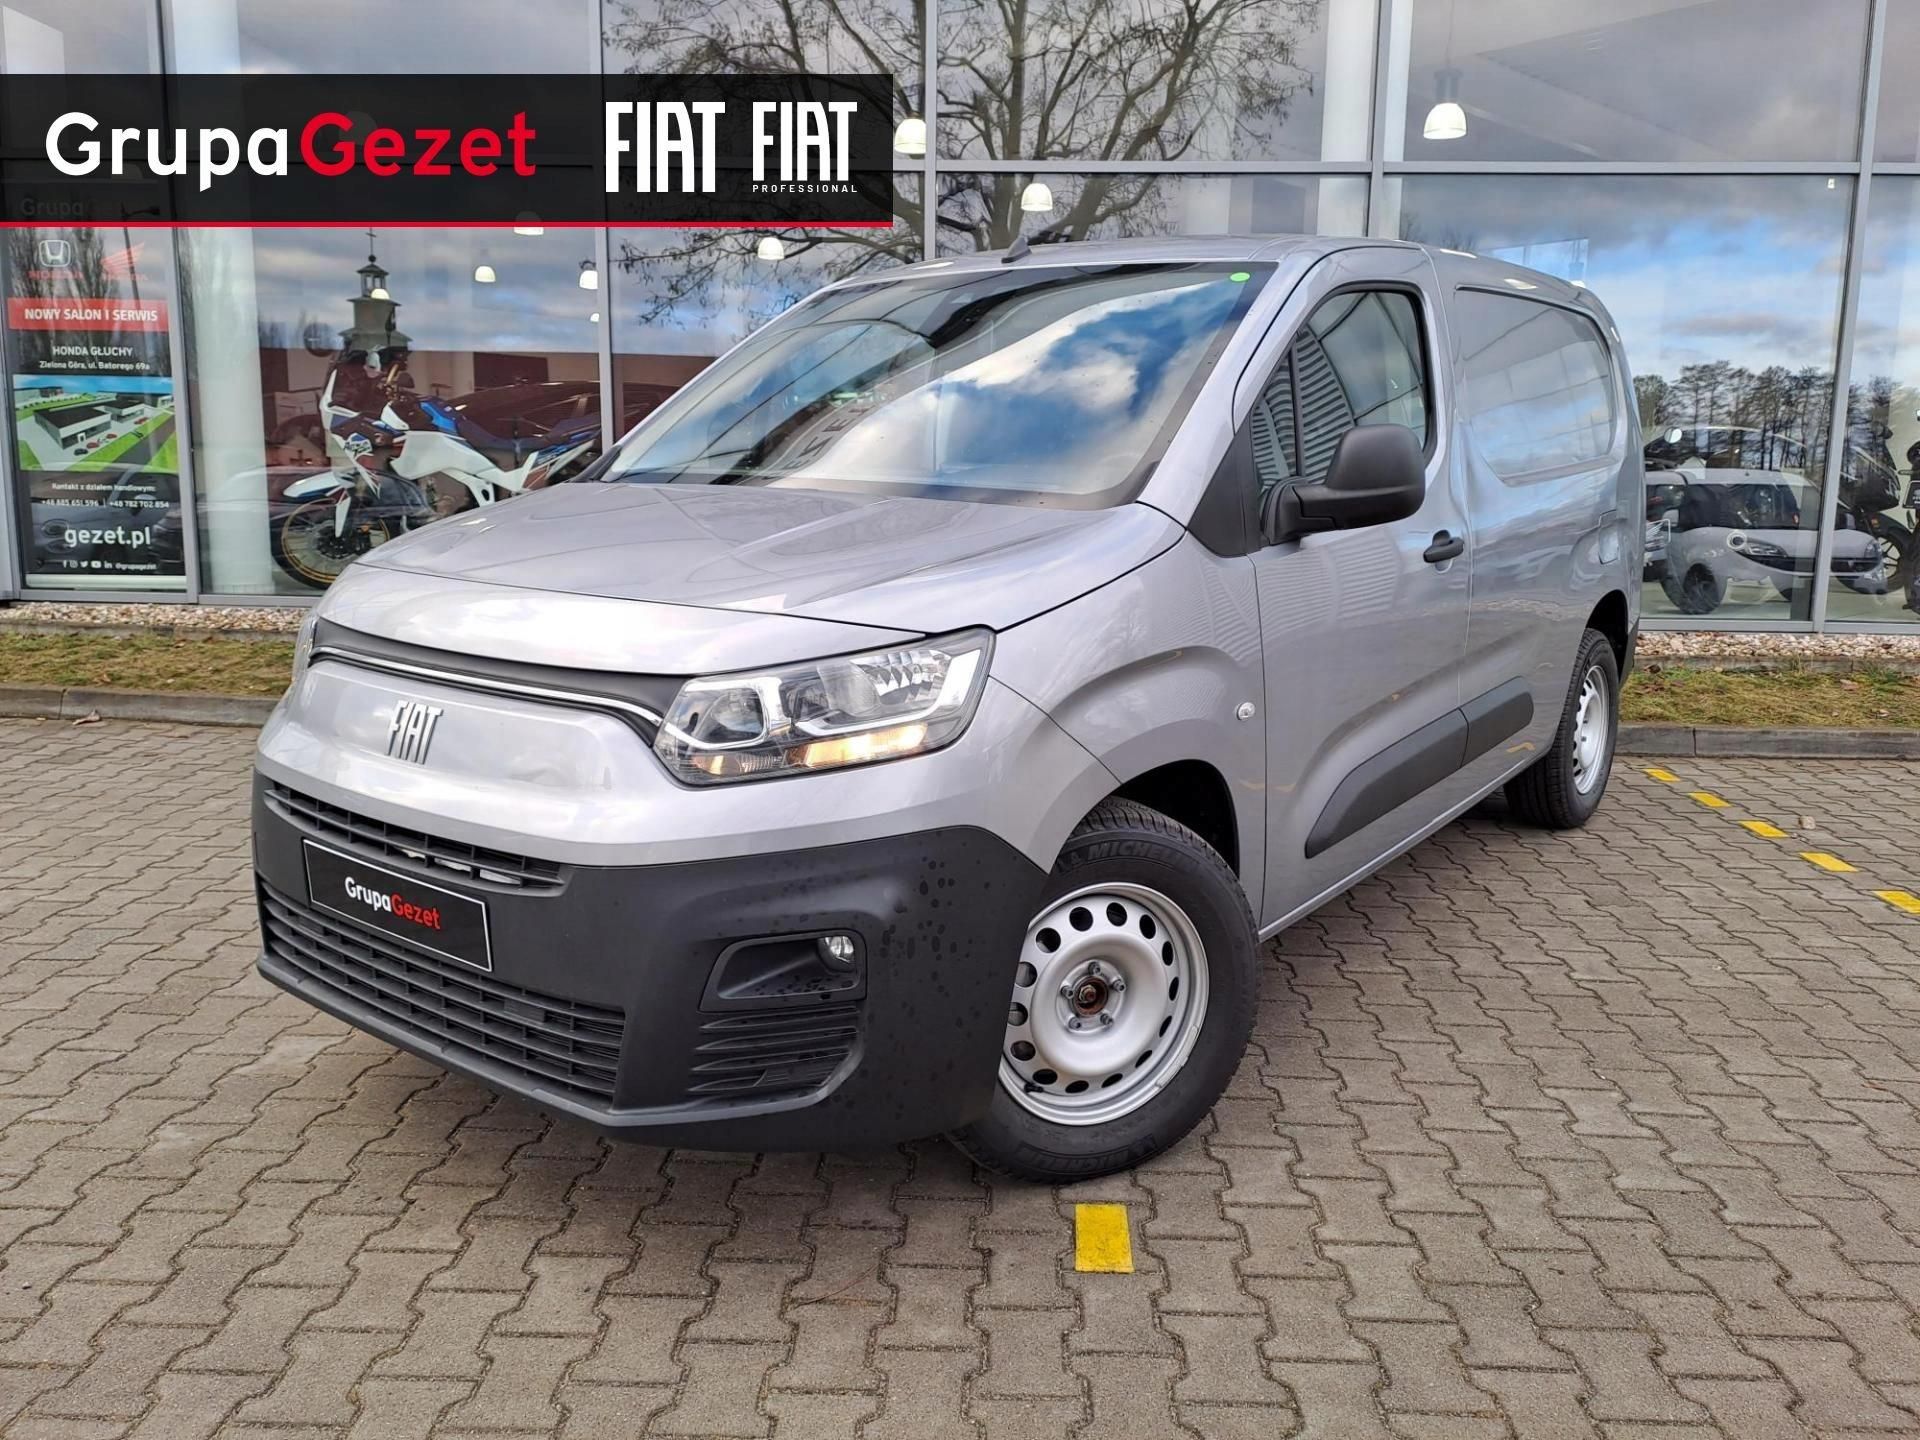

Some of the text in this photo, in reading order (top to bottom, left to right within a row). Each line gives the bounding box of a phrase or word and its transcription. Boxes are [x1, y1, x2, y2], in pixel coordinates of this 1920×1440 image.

[24, 308, 158, 322] NOWY SALON I SERWIS
[52, 346, 134, 357] HONDA GŁUCHY
[39, 360, 67, 369] Zielona
[67, 361, 87, 370] Góra,
[98, 361, 134, 371] Batorego
[52, 483, 79, 491] Kontakt
[64, 526, 151, 549] gezet.pl
[384, 699, 444, 765] FIAT
[345, 876, 441, 930] GrupaGezet
